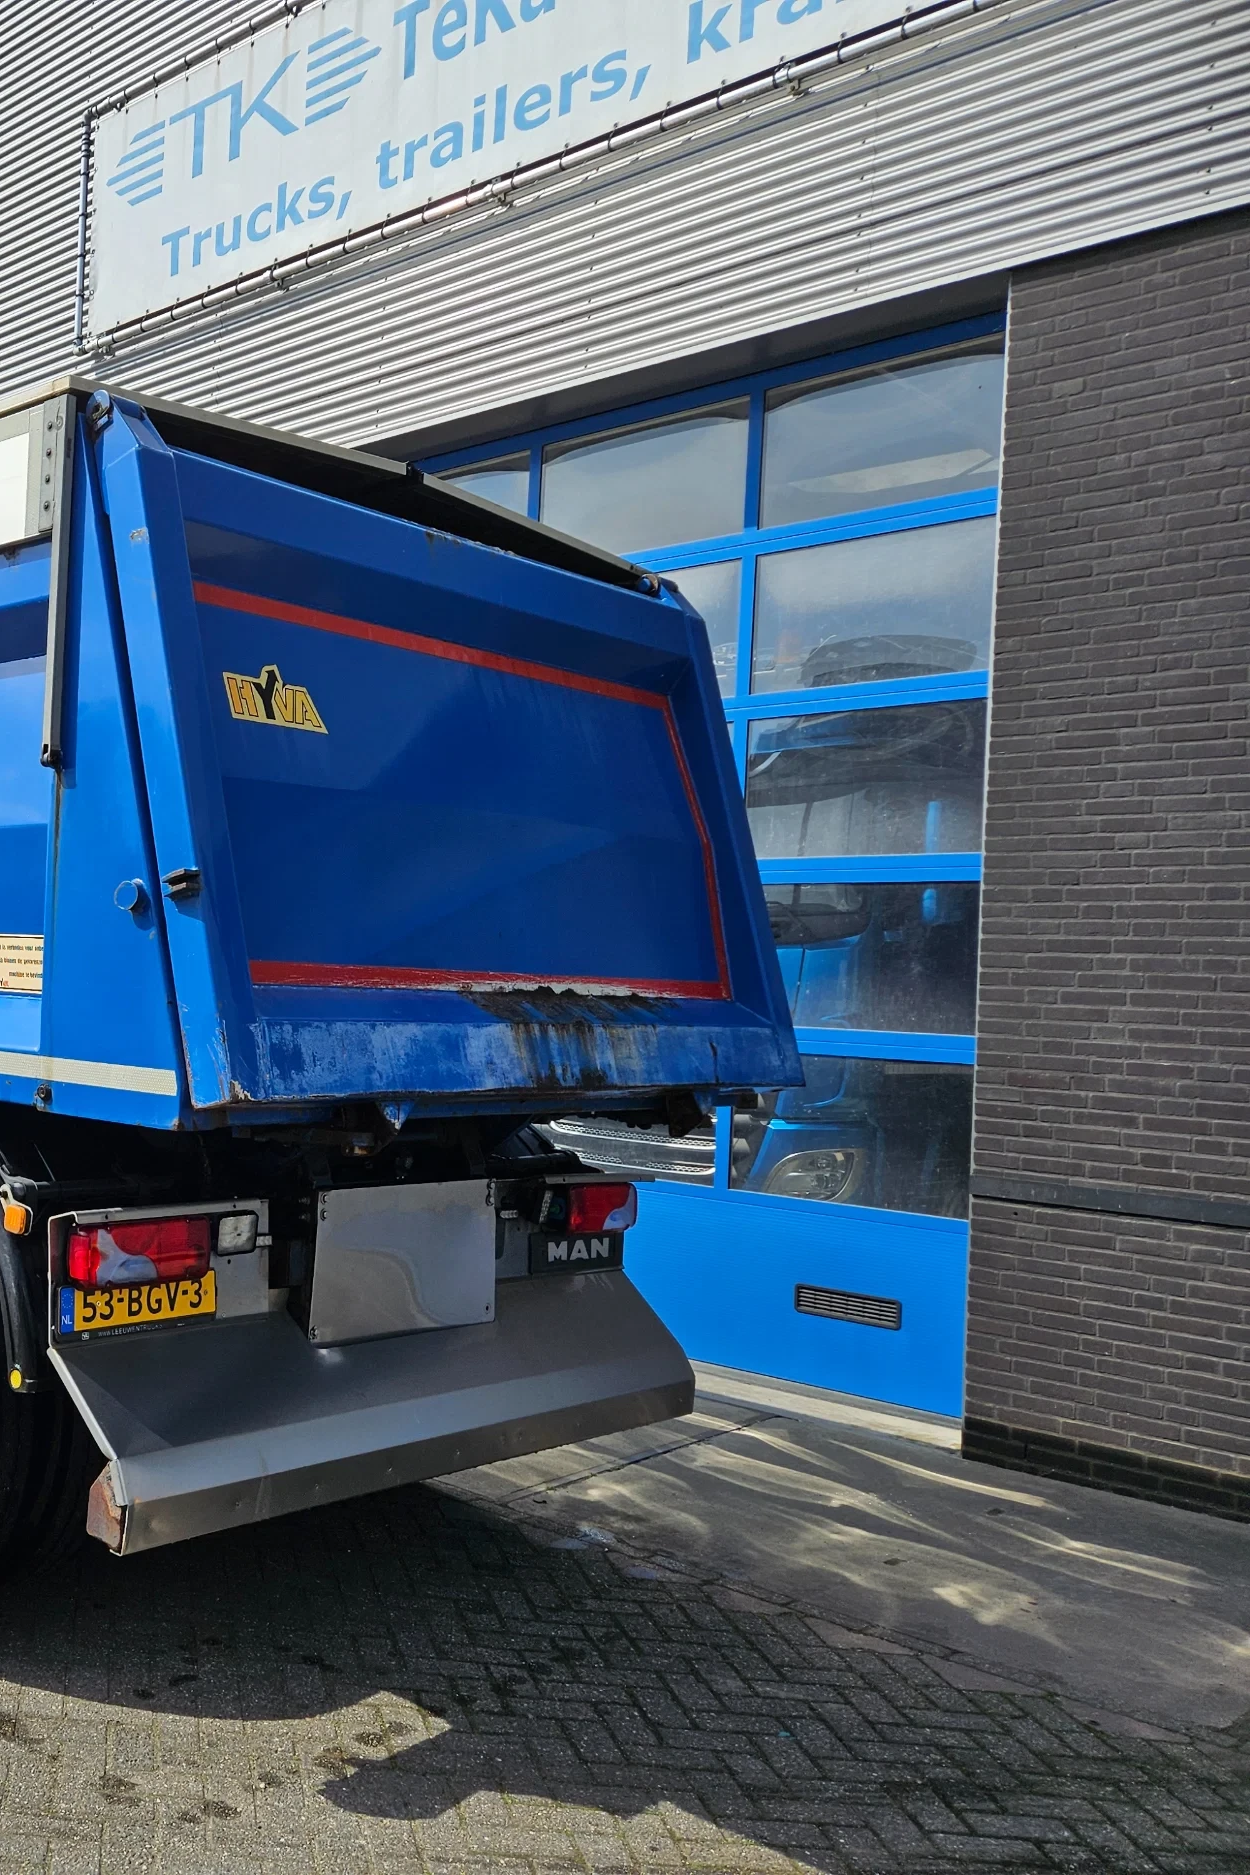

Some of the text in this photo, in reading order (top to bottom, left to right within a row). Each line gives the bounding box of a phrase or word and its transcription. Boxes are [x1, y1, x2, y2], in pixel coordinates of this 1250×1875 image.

[161, 174, 352, 278] Trucks,
[376, 48, 653, 190] trailers,
[226, 669, 323, 729] HYVA
[547, 1237, 610, 1263] MAN
[61, 1315, 73, 1325] NL
[82, 1278, 203, 1323] 53-BGV-3
